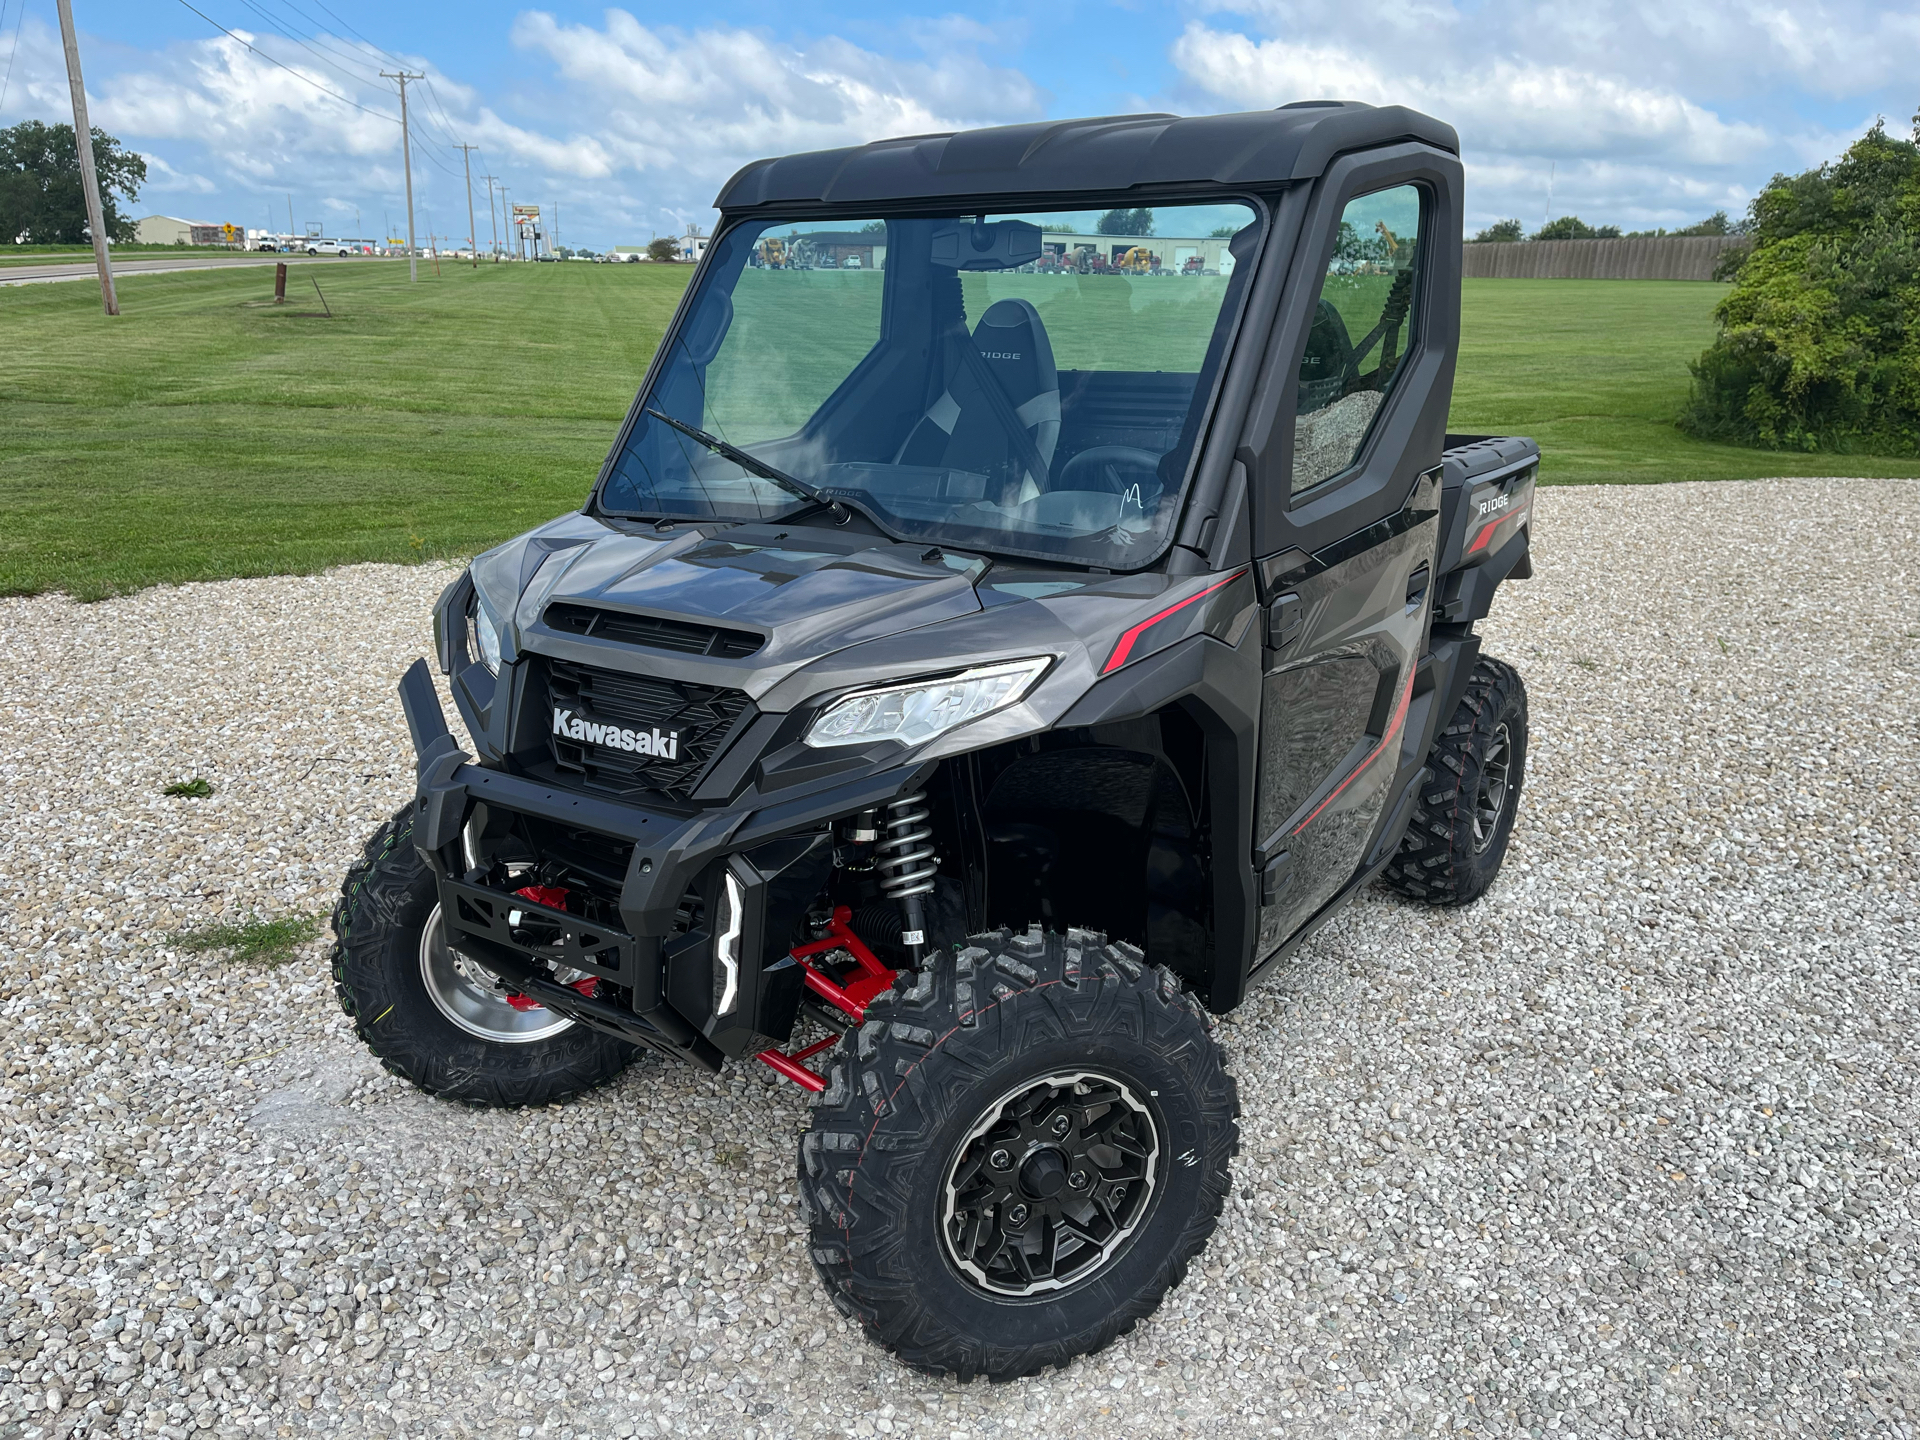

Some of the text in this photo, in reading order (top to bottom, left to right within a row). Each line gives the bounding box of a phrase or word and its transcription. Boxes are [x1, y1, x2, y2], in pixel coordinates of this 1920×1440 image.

[980, 351, 1021, 360] RIDGE
[825, 488, 863, 498] RIDGE
[1479, 493, 1509, 516] RIDGE
[553, 707, 678, 760] Kawasaki
